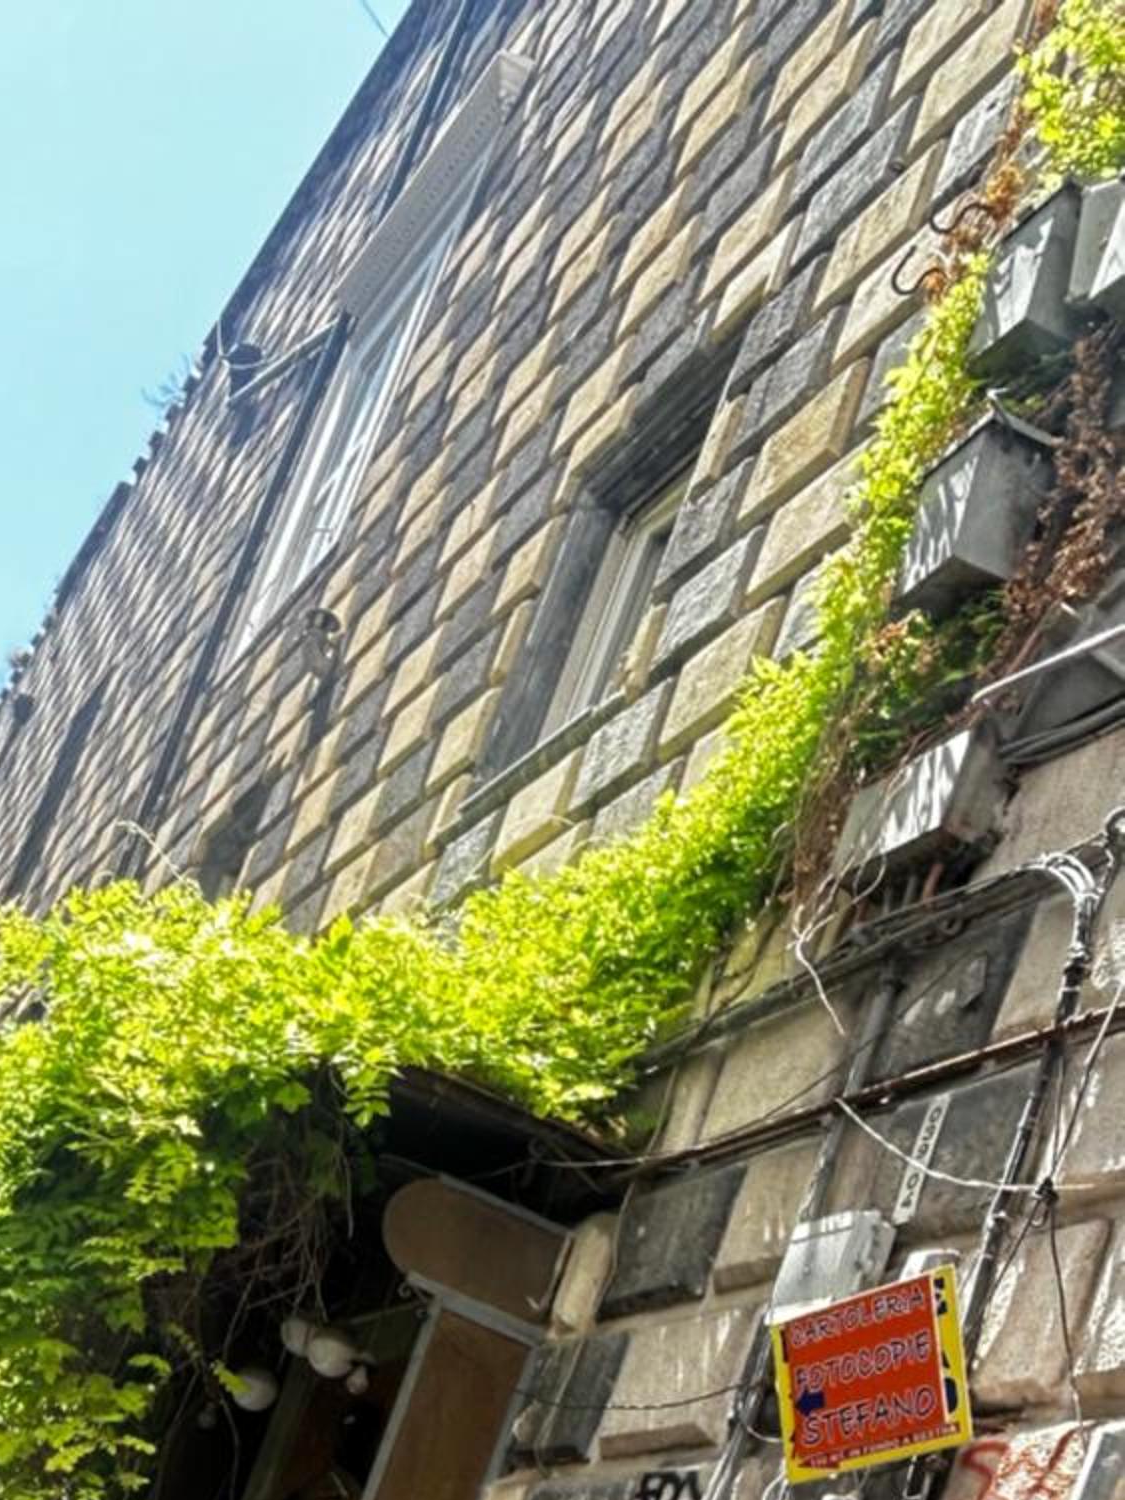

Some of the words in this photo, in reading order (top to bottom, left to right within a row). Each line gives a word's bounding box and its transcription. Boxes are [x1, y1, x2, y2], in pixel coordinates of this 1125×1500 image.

[790, 1283, 926, 1347] CARTOLERIA
[794, 1331, 931, 1394] FOTOCOPIE
[800, 1386, 937, 1447] STEFANO
